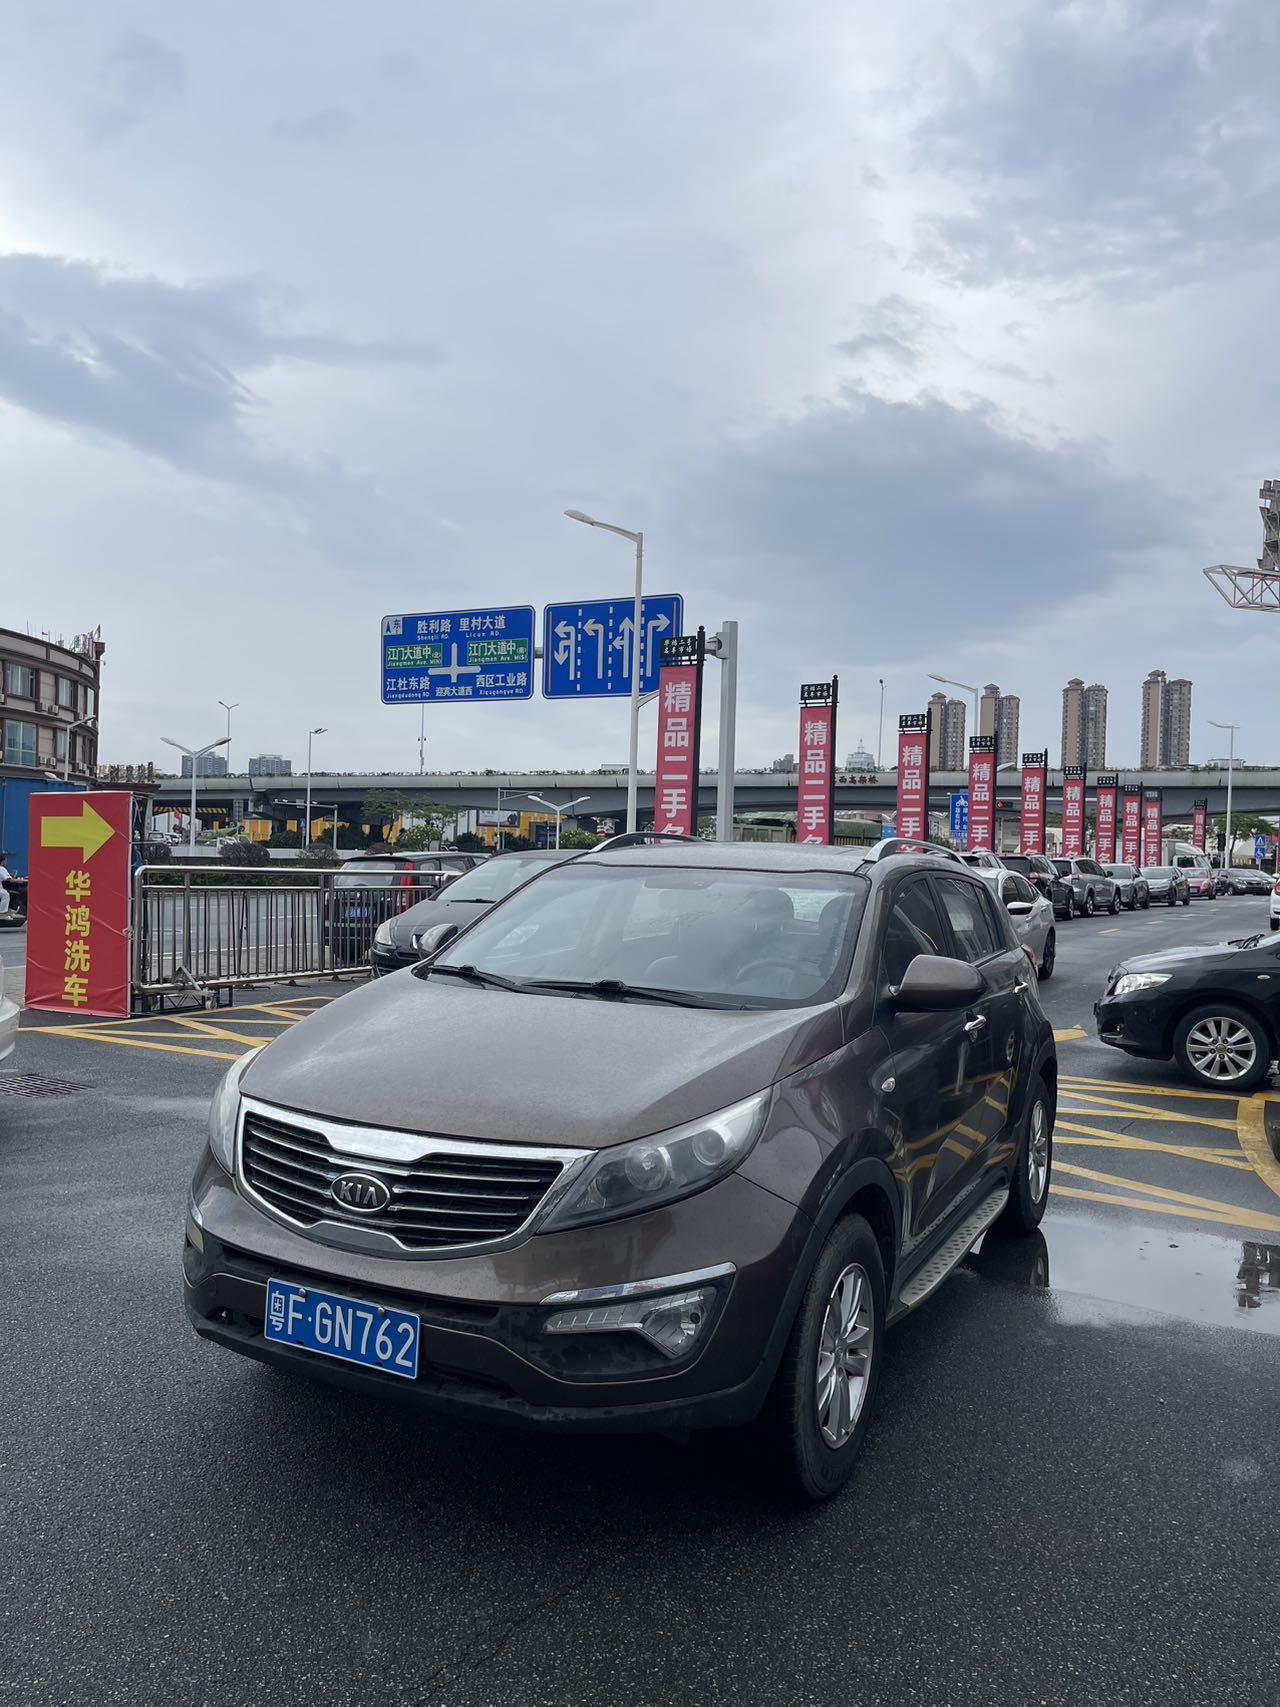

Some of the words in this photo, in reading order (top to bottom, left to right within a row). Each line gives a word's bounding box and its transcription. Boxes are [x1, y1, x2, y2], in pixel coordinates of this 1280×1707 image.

[417, 619, 451, 634] 胜利路
[459, 615, 506, 631] 里村大道
[386, 676, 430, 691] 江杜东路
[475, 671, 528, 688] 西区工业路
[435, 686, 473, 697] 迎宾大道西
[834, 774, 879, 785] 西高架桥
[900, 745, 923, 846] 精品二手
[970, 763, 991, 850] 精品二手
[61, 870, 91, 1007] 华鸿洗车
[339, 1181, 379, 1206] KIA
